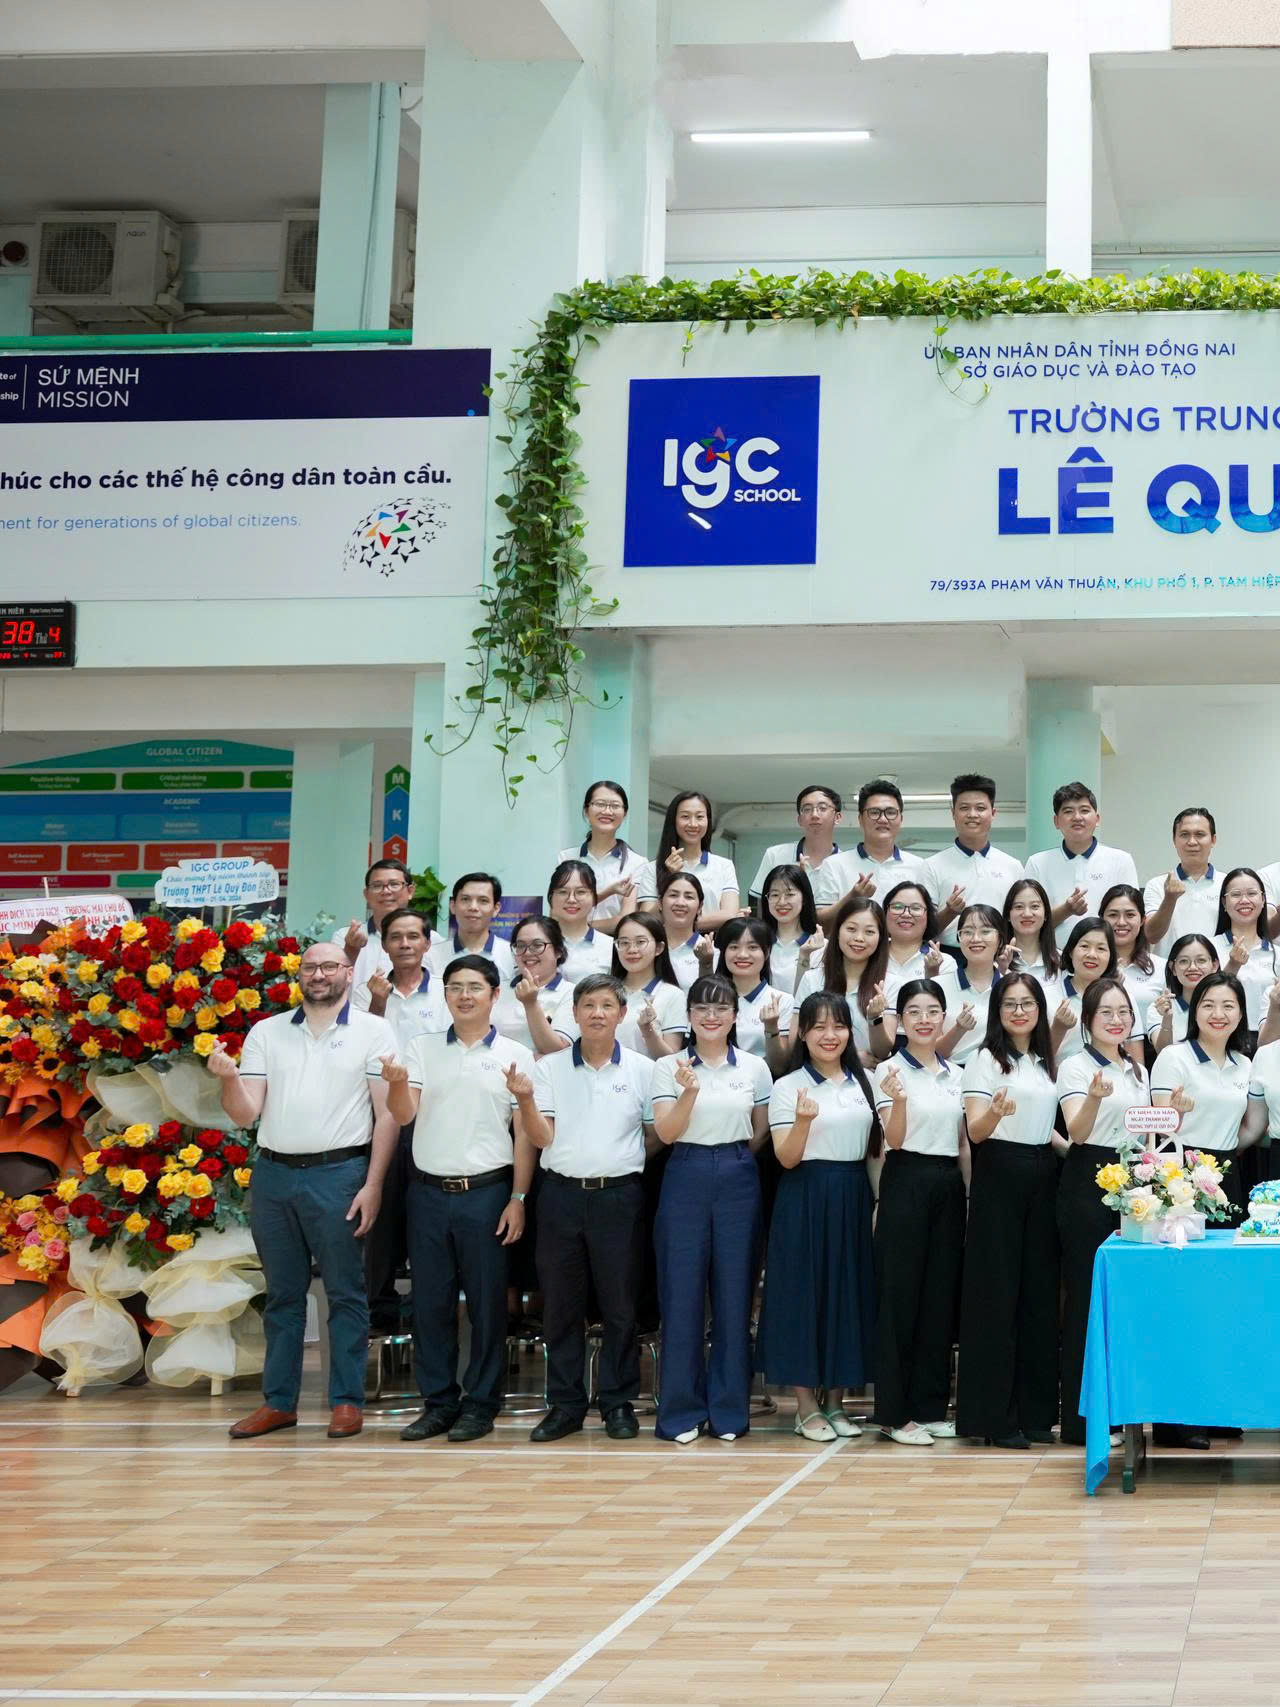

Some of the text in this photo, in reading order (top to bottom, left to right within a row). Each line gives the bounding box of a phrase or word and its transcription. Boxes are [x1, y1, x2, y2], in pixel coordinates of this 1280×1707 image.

[954, 346, 991, 359] BAN
[997, 342, 1048, 358] NHÂN
[1055, 341, 1092, 358] DÂN
[1098, 339, 1139, 357] TỈNH
[1145, 338, 1199, 356] ĐỒNG
[1205, 343, 1236, 356] NAI
[38, 365, 140, 388] SỨ MỆNH
[963, 360, 1196, 380] SỞ GIÁO DỤC VÀ ĐÀO TẠO
[38, 390, 129, 408] MISSION
[1008, 401, 1160, 434] TRƯỜNG
[49, 471, 92, 489] cho
[99, 470, 139, 489] các
[146, 466, 187, 488] thế
[191, 468, 219, 492] hệ
[226, 467, 284, 490] công
[292, 467, 336, 486] dân
[343, 466, 396, 485] toàn
[404, 462, 452, 484] cầu.
[734, 488, 801, 502] SCHOOL
[998, 446, 1114, 536] LÊ
[37, 516, 59, 529] for
[64, 514, 157, 532] generations
[162, 514, 179, 528] of
[184, 514, 233, 531] global
[930, 579, 987, 592] 79/393A
[992, 579, 1031, 592] PHẠM
[1035, 576, 1064, 590] VĂN
[1124, 577, 1151, 589] KHU
[2, 621, 35, 645] 38
[49, 626, 61, 643] 4
[146, 746, 224, 756] GLOBAL CITIZEN
[392, 773, 405, 784] M
[392, 809, 402, 821] K
[391, 844, 400, 855] S
[191, 861, 249, 872] IGC GROUP
[192, 884, 211, 895] THPT
